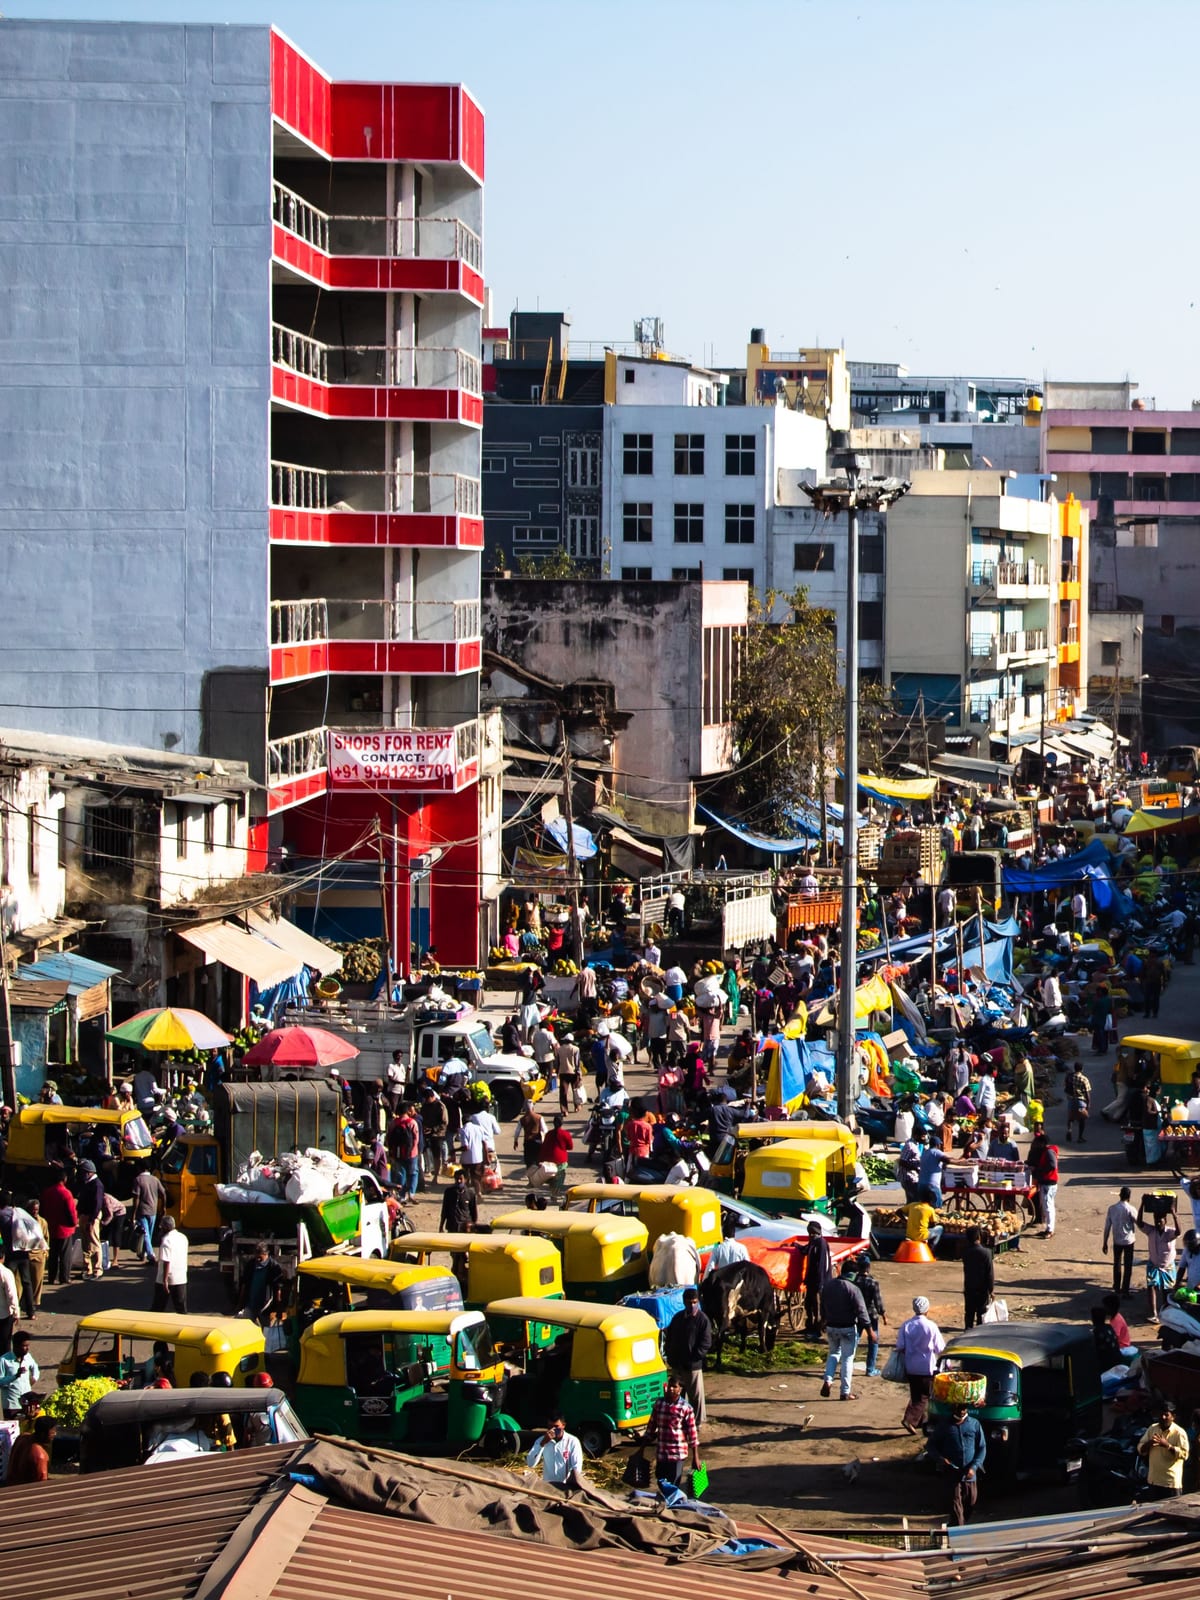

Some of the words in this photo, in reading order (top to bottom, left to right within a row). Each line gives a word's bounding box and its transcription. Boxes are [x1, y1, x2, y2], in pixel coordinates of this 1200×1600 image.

[335, 735, 380, 751] SHOPS
[385, 735, 412, 750] FOR
[416, 735, 452, 750] RENT
[361, 753, 425, 763] CONTACT:
[335, 764, 359, 779] +91
[364, 764, 452, 779] 9341225703
